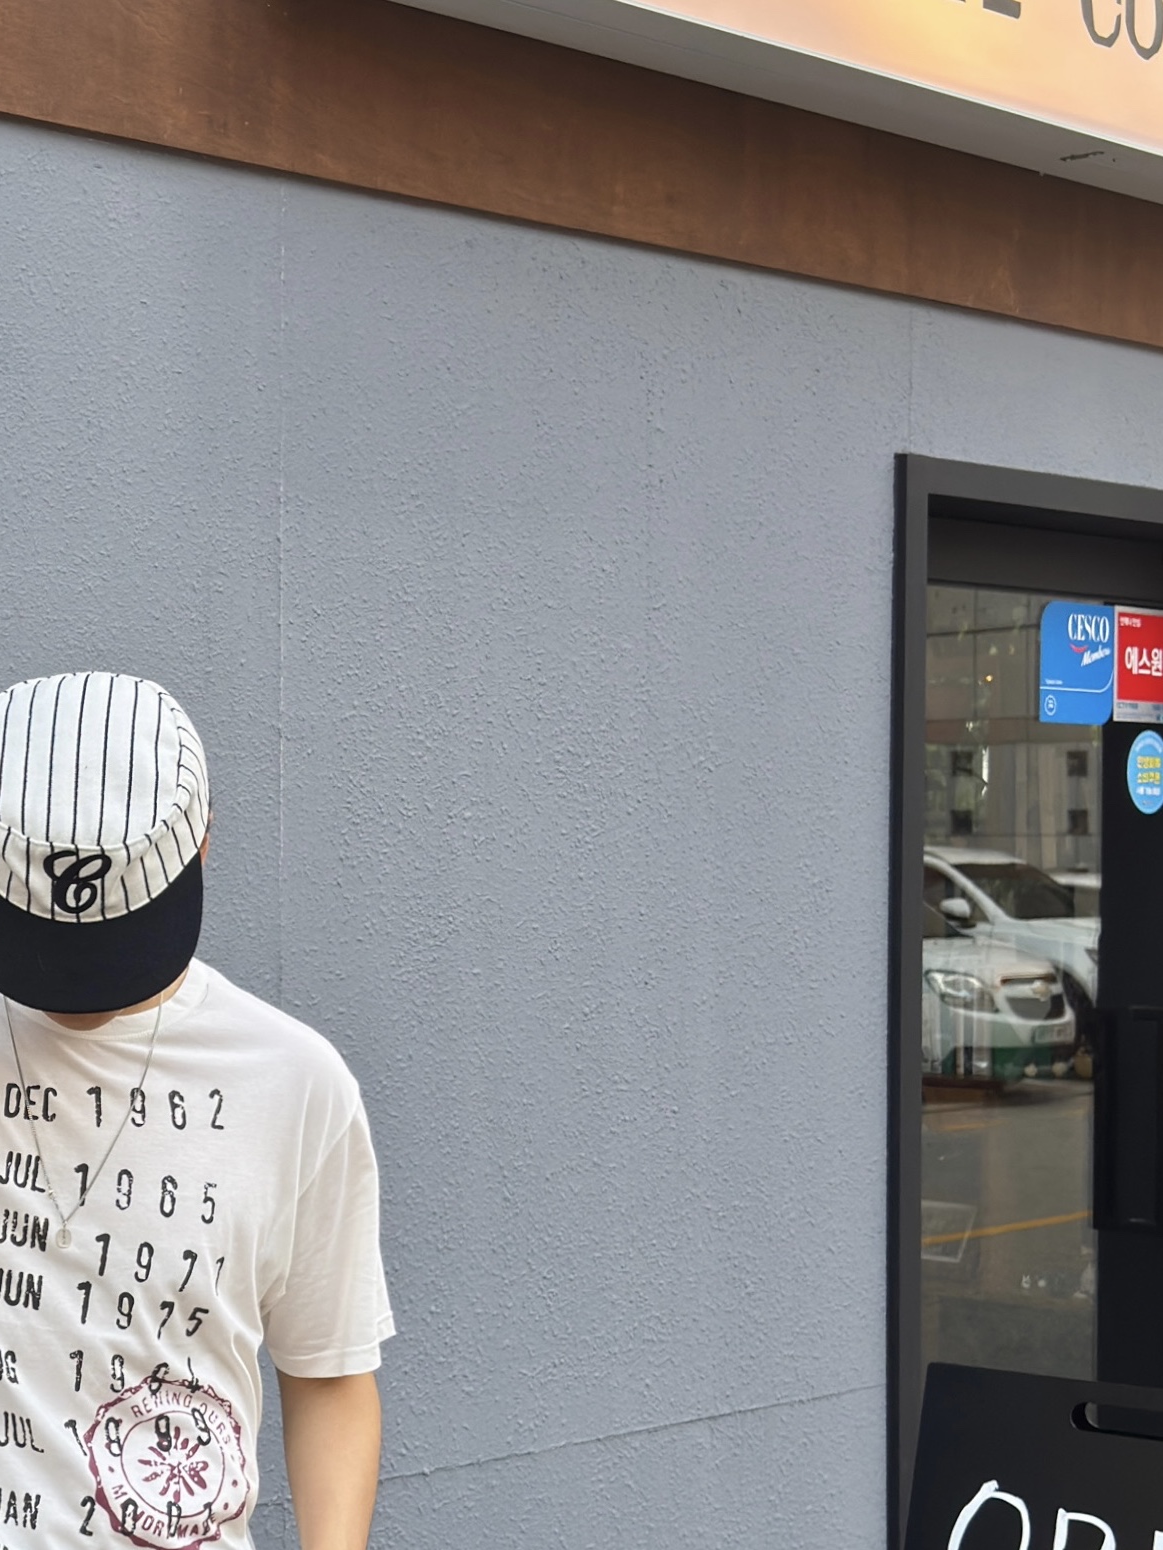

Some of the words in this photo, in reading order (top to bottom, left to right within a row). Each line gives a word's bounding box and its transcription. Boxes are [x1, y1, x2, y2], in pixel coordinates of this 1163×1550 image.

[1067, 613, 1110, 643] CESCO
[1124, 646, 1163, 677] 에스원
[3, 1082, 58, 1123] DEC
[86, 1085, 225, 1131] 1962
[73, 1162, 218, 1225] 1965
